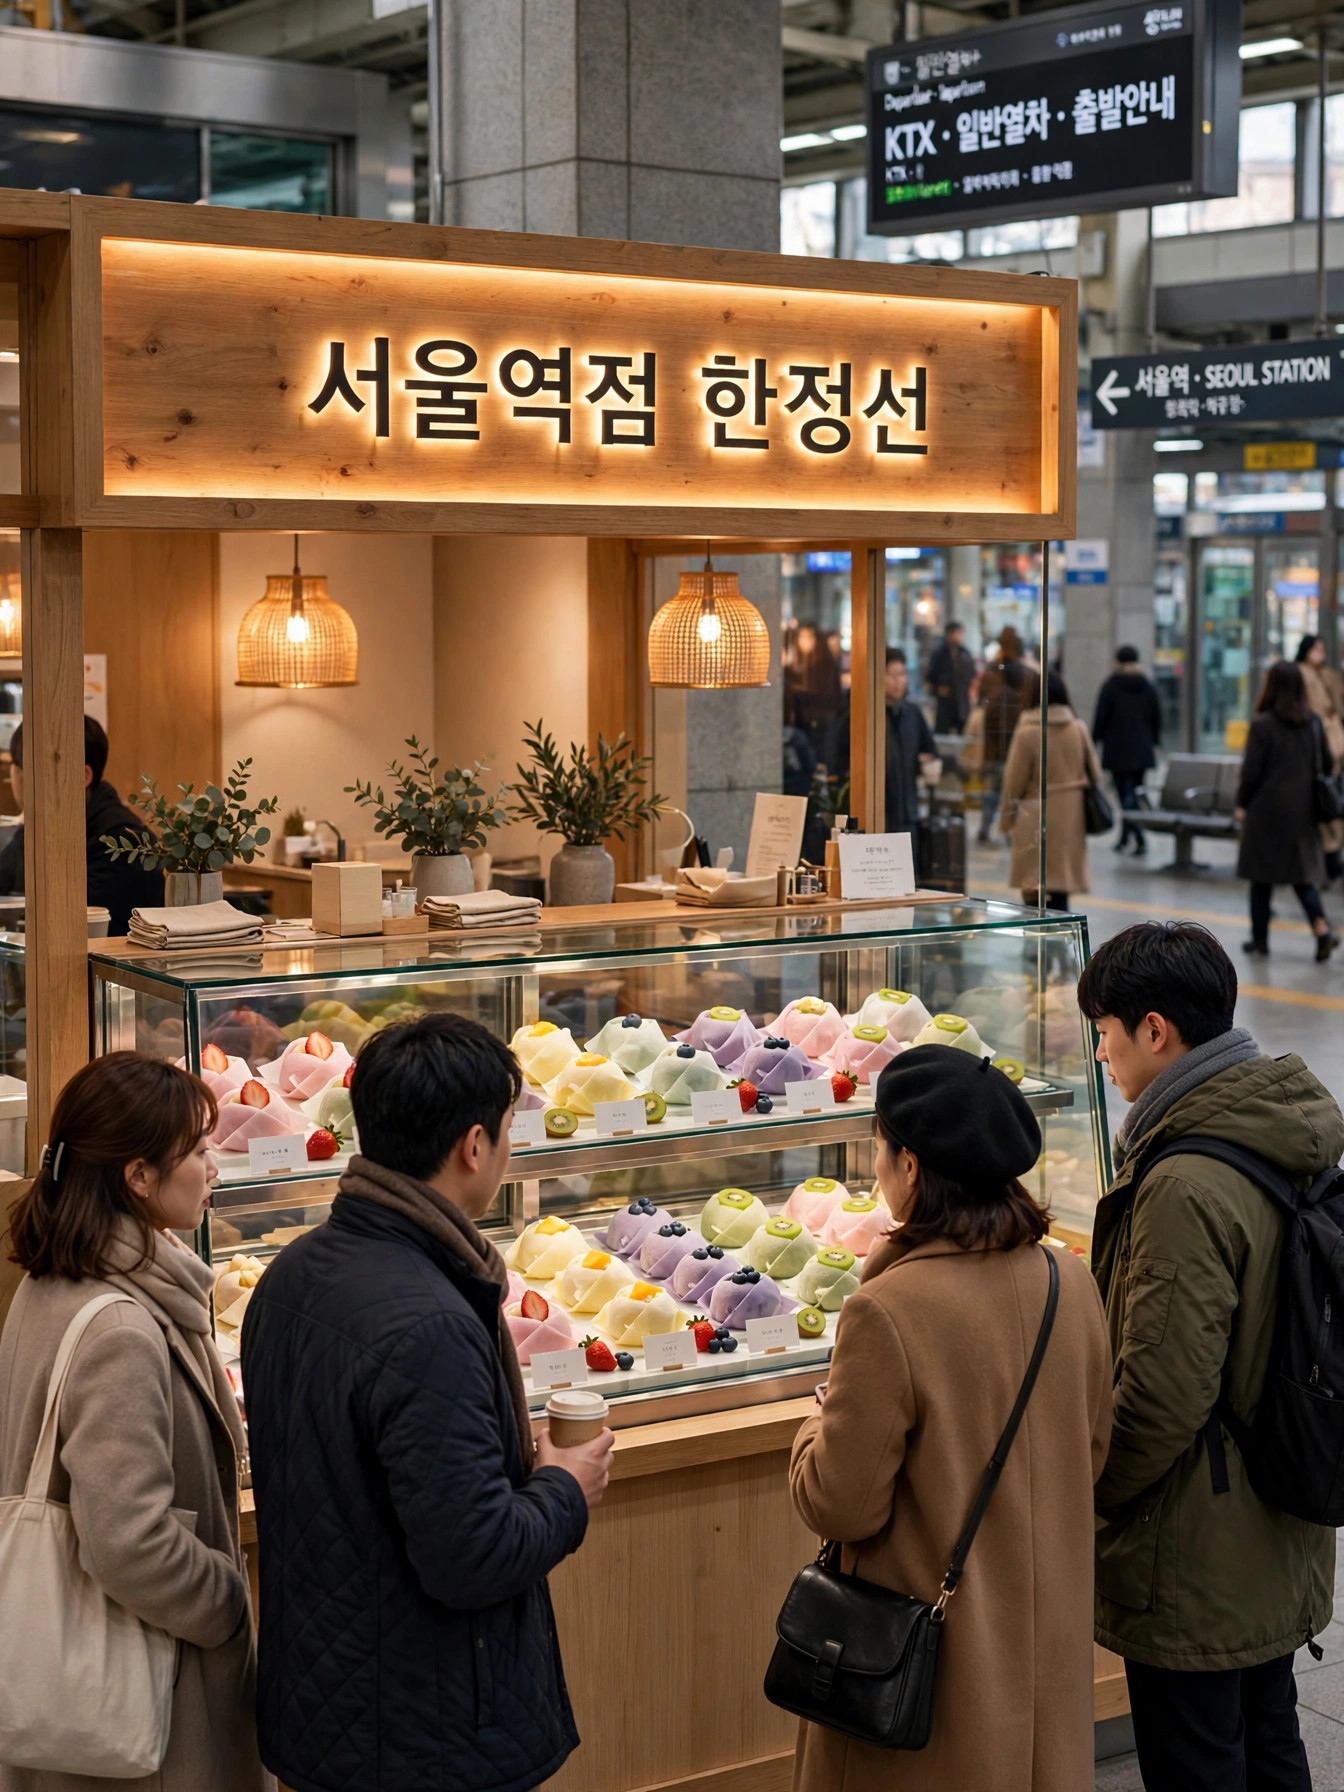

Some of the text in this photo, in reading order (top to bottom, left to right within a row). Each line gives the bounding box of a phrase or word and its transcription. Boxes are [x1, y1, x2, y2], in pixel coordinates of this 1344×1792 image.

[885, 75, 1176, 161] KTX 일반열차 출발안내
[308, 337, 928, 455] 서울역점 한정선
[1134, 356, 1331, 397] 서울역 SEOUL STATION
